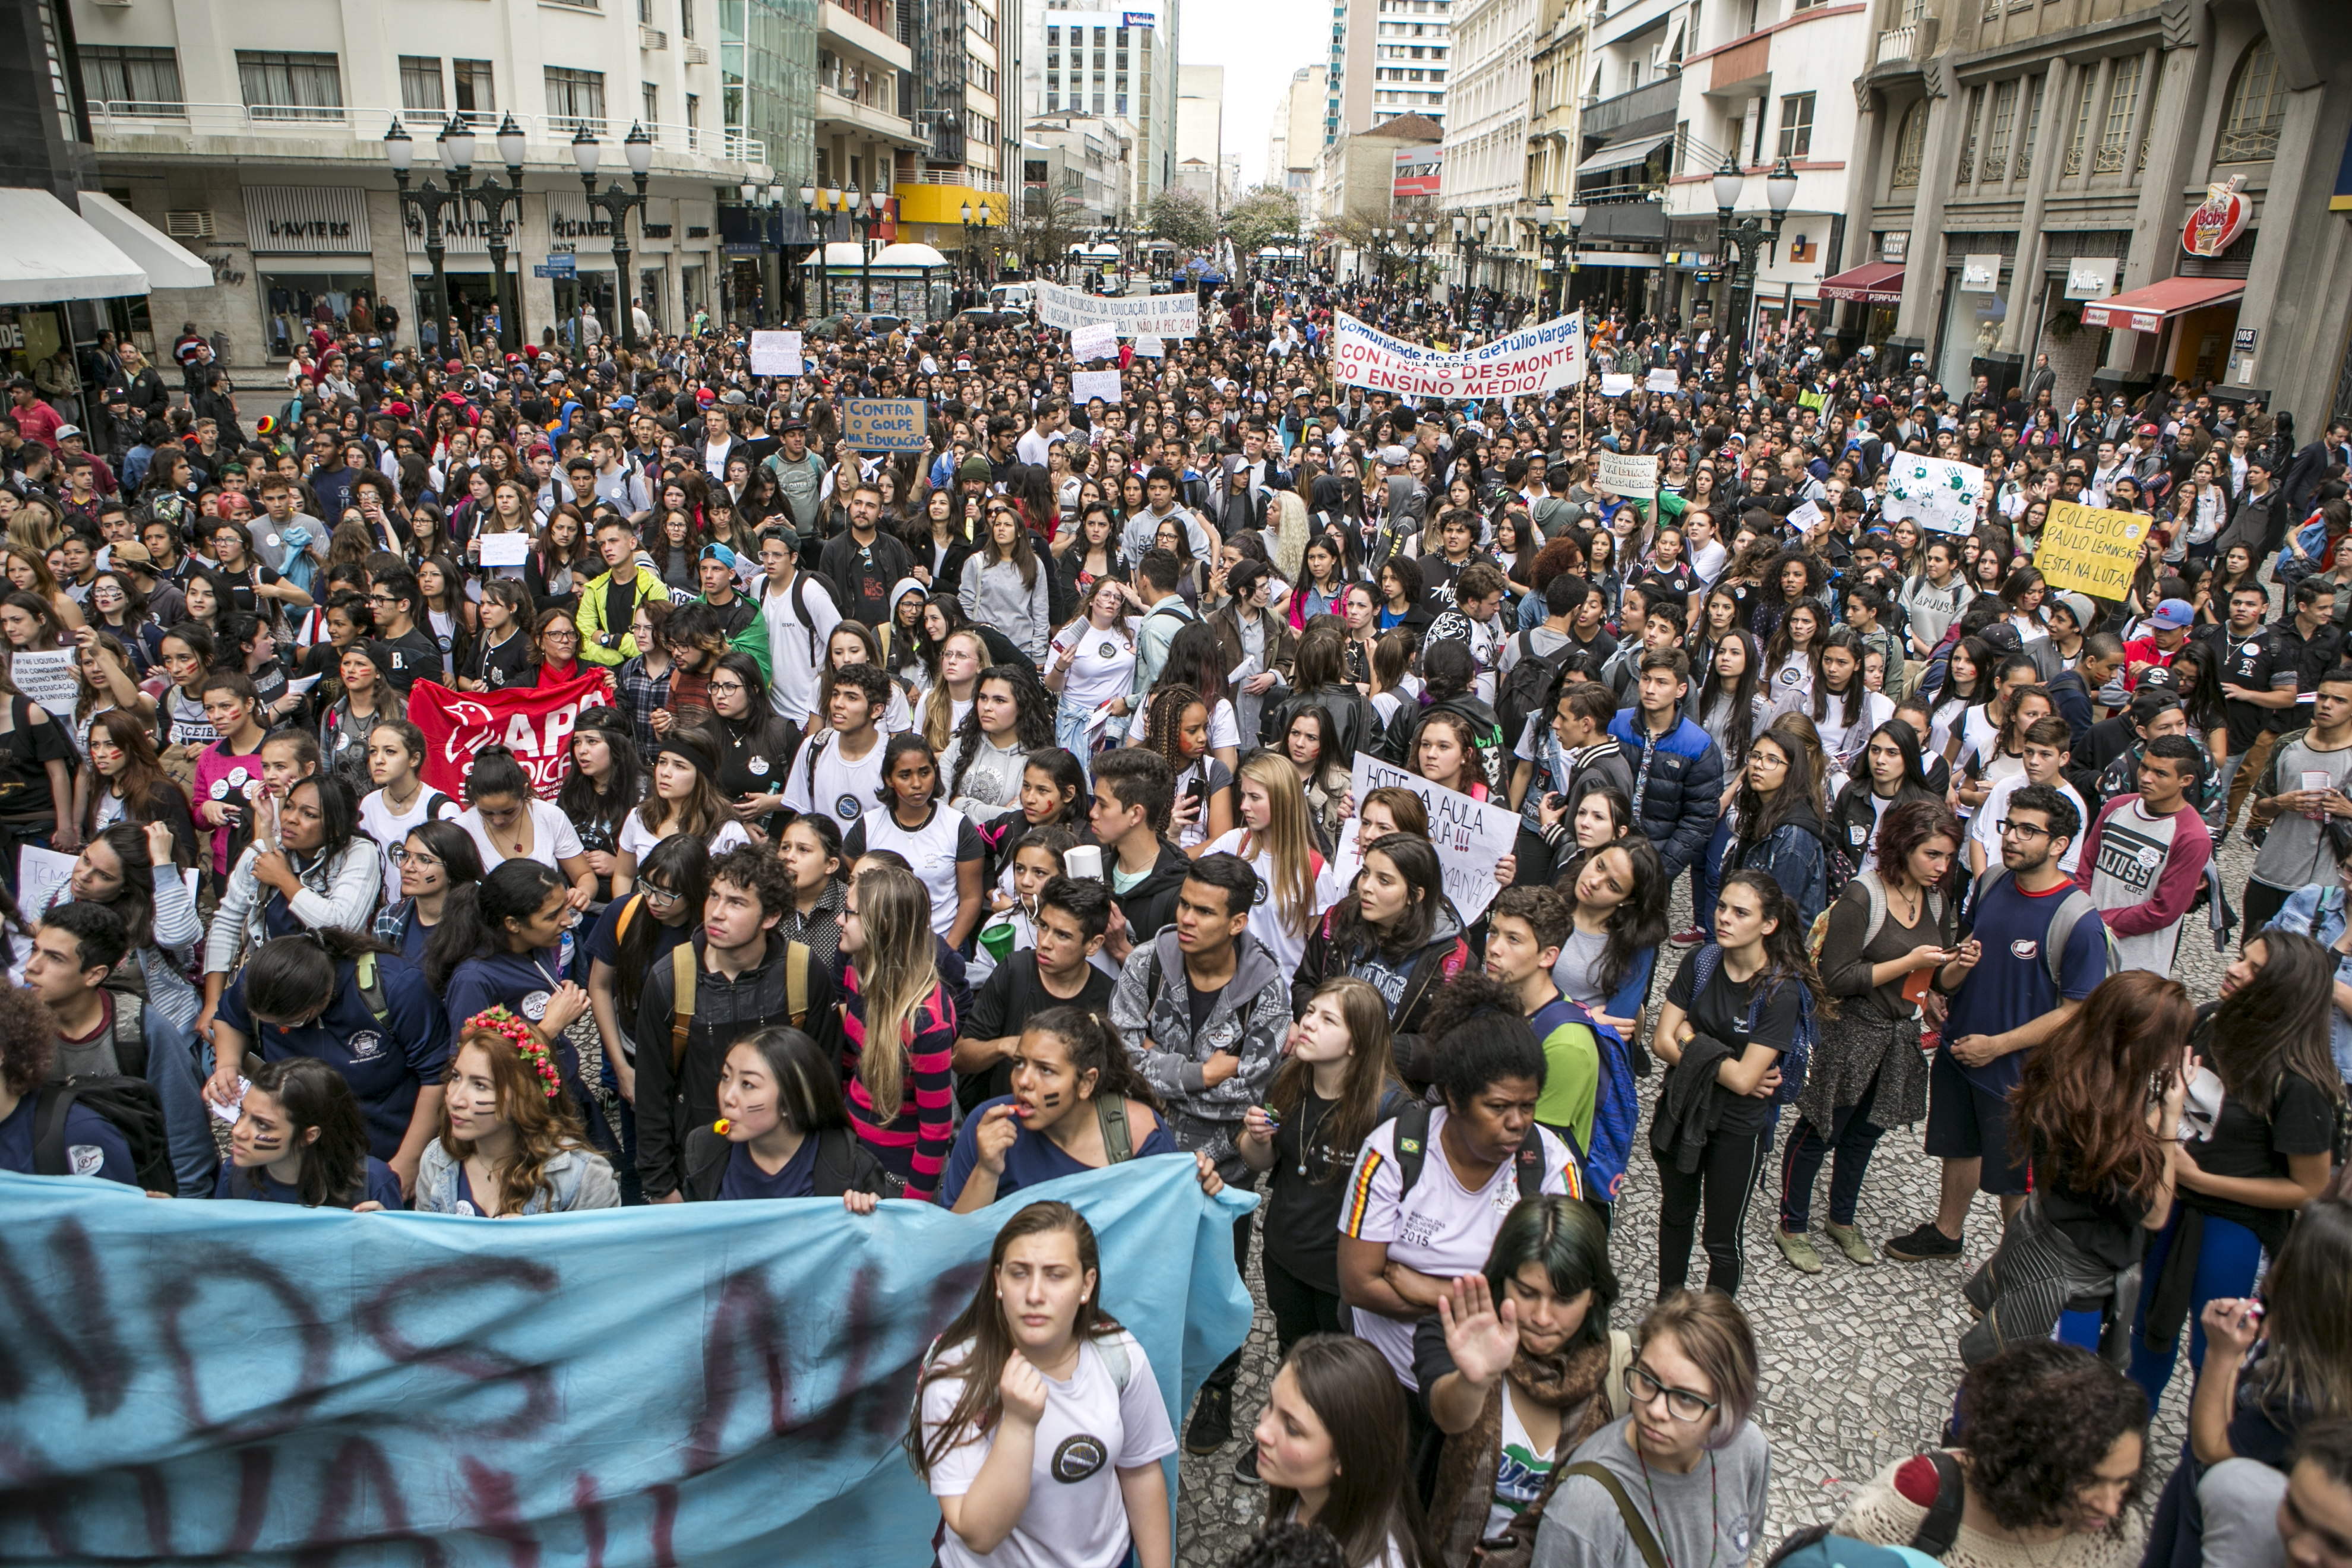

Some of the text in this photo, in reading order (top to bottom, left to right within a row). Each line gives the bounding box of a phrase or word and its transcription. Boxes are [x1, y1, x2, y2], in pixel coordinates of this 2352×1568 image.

[2198, 207, 2227, 227] Bob's
[1886, 232, 1905, 241] CASA
[2196, 226, 2221, 245] Shake
[1884, 243, 1903, 253] SADE
[1964, 264, 1991, 283] billie
[2070, 270, 2105, 289] billie
[1047, 288, 1068, 307] CONGELAR
[1070, 295, 1096, 313] RECURSOS
[1099, 303, 1108, 315] DA
[1111, 300, 1148, 317] EDUCAÇÃO
[1152, 302, 1156, 314] E
[1159, 301, 1168, 314] DA
[1172, 296, 1196, 313] SAÚDE
[1869, 293, 1901, 302] PERFUM
[1047, 304, 1050, 319] É
[1051, 309, 1070, 324] RASGAR
[1074, 315, 1078, 326] A
[1137, 317, 1152, 333] NÃO
[1155, 318, 1159, 333] À
[1164, 320, 1177, 332] PEC
[1181, 318, 1194, 331] 241
[0, 324, 23, 349] DE
[754, 334, 787, 344] SEMEIE
[1339, 317, 1421, 360] Comunidade
[1425, 350, 1444, 361] do
[1478, 334, 1537, 359] Getúlio
[1538, 320, 1578, 343] Vargas
[2237, 330, 2253, 342] 103
[754, 353, 795, 365] E COLHA
[1342, 343, 1575, 380] CONTRA O DESMONTE
[1074, 374, 1084, 384] EU
[1086, 372, 1098, 381] NÃO
[1337, 362, 1547, 395] DO ENSINO MÉDIO!
[850, 401, 914, 417] CONTRA
[853, 419, 913, 432] O GOLPE
[848, 432, 925, 448] NA EDUCAÇÃO
[1603, 451, 1656, 466] ESSA REFORMA
[1604, 463, 1617, 475] VAI
[1599, 475, 1655, 489] A NOSSA HISTÓRIA
[1892, 500, 1951, 523] TEMER
[2057, 508, 2126, 538] COLÉGIO
[2046, 526, 2089, 551] PAULO
[2042, 554, 2132, 590] ESTÁ NA LUTA!
[392, 652, 409, 669] B.
[39, 682, 75, 691] EDUCAÇÃO
[1439, 796, 1483, 835] AULA
[2123, 884, 2144, 896] 4LIFE
[1408, 1216, 1439, 1232] MULHERES
[1411, 1210, 1446, 1229] MARCHA DAS
[1400, 1228, 1429, 1247] 2015
[1405, 1221, 1433, 1237] NEGRAS
